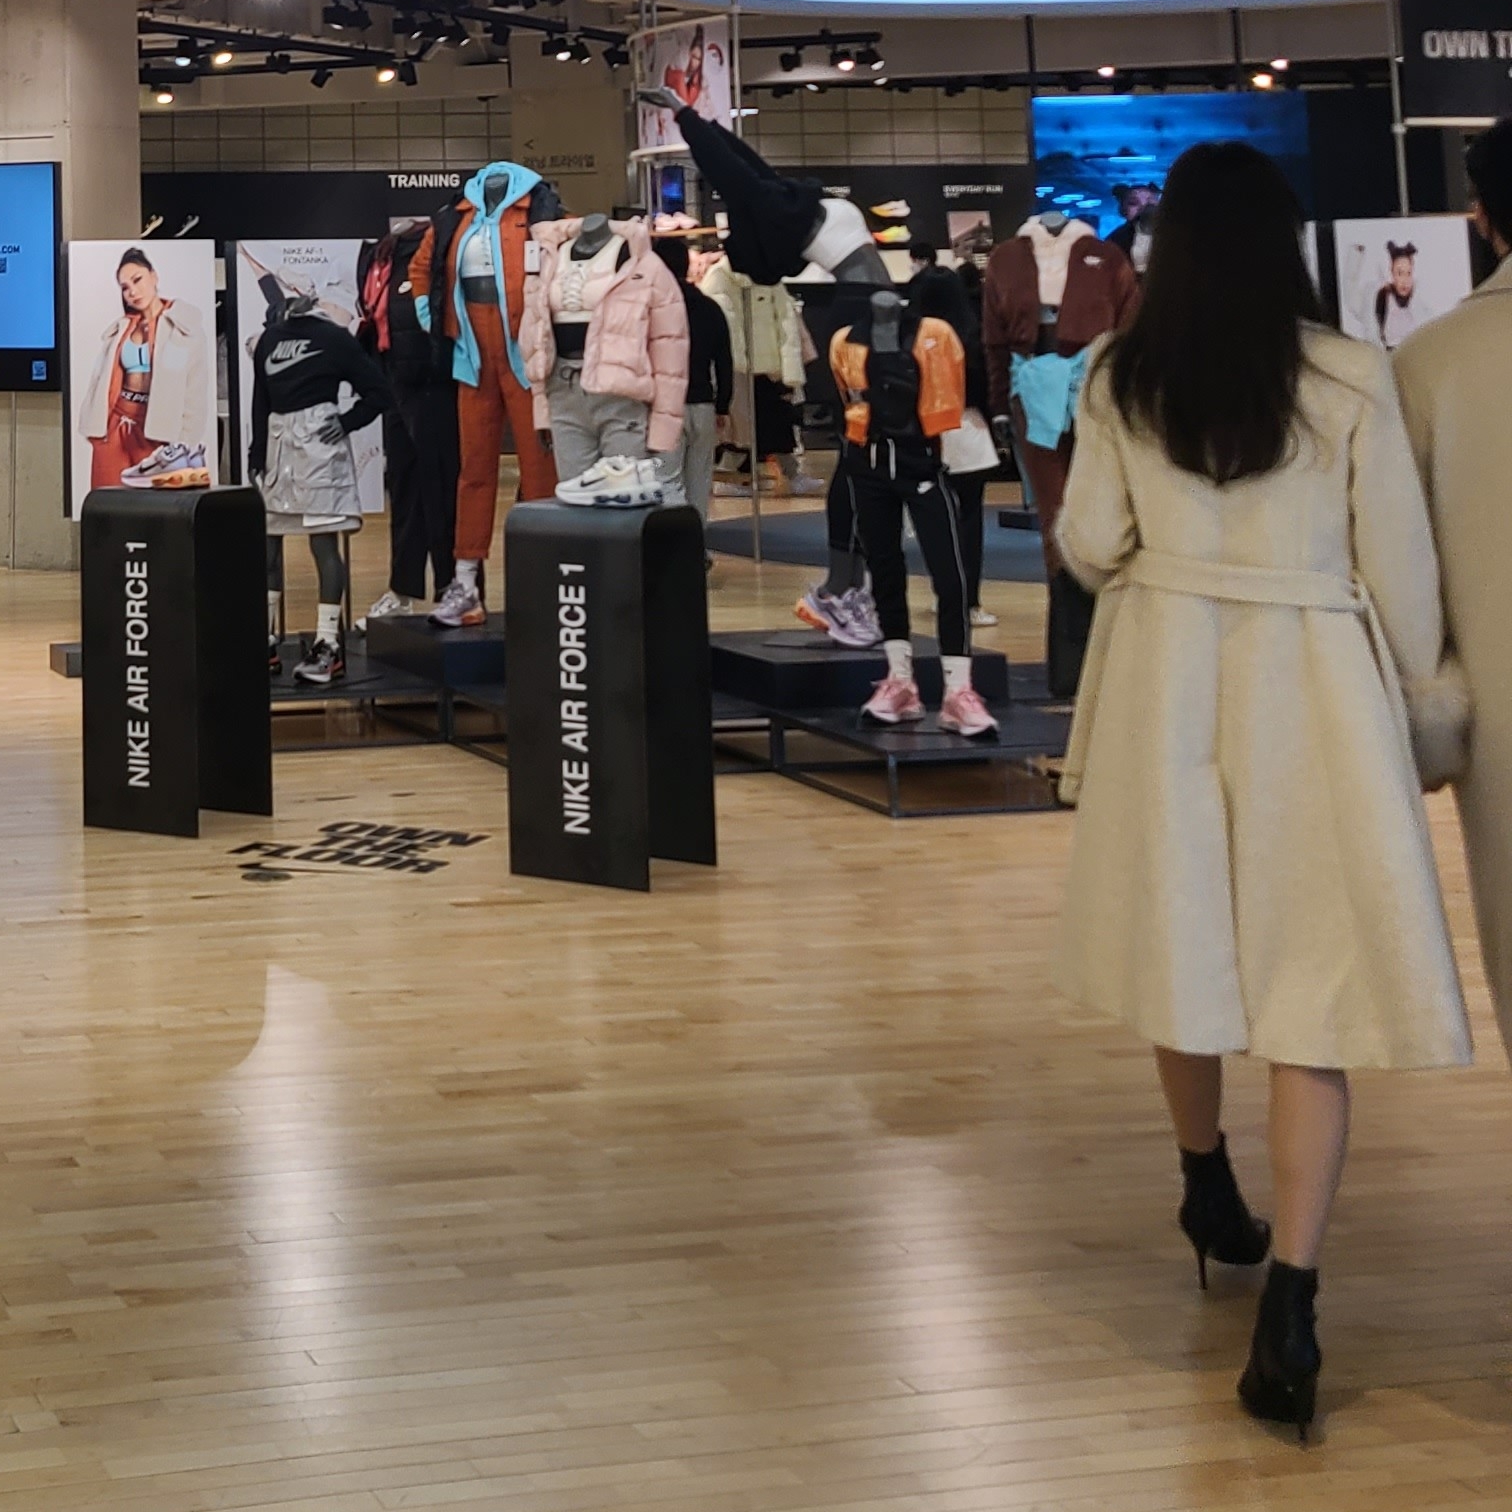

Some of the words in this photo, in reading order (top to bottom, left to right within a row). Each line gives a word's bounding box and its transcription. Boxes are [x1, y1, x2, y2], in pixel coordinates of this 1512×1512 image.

[1423, 30, 1489, 59] OWN
[1491, 30, 1512, 59] T
[388, 173, 461, 188] TRAINING
[271, 339, 311, 360] NIKE
[125, 541, 147, 553] 1
[558, 563, 585, 577] 1
[125, 561, 149, 656] FORCE
[558, 584, 588, 691] FORCE
[126, 665, 149, 713] AIR
[560, 699, 589, 753] AIR
[127, 720, 150, 787] NIKE
[562, 759, 591, 835] NIKE
[310, 831, 440, 857] THE
[317, 821, 492, 847] OWN
[227, 842, 450, 874] FLOOR
